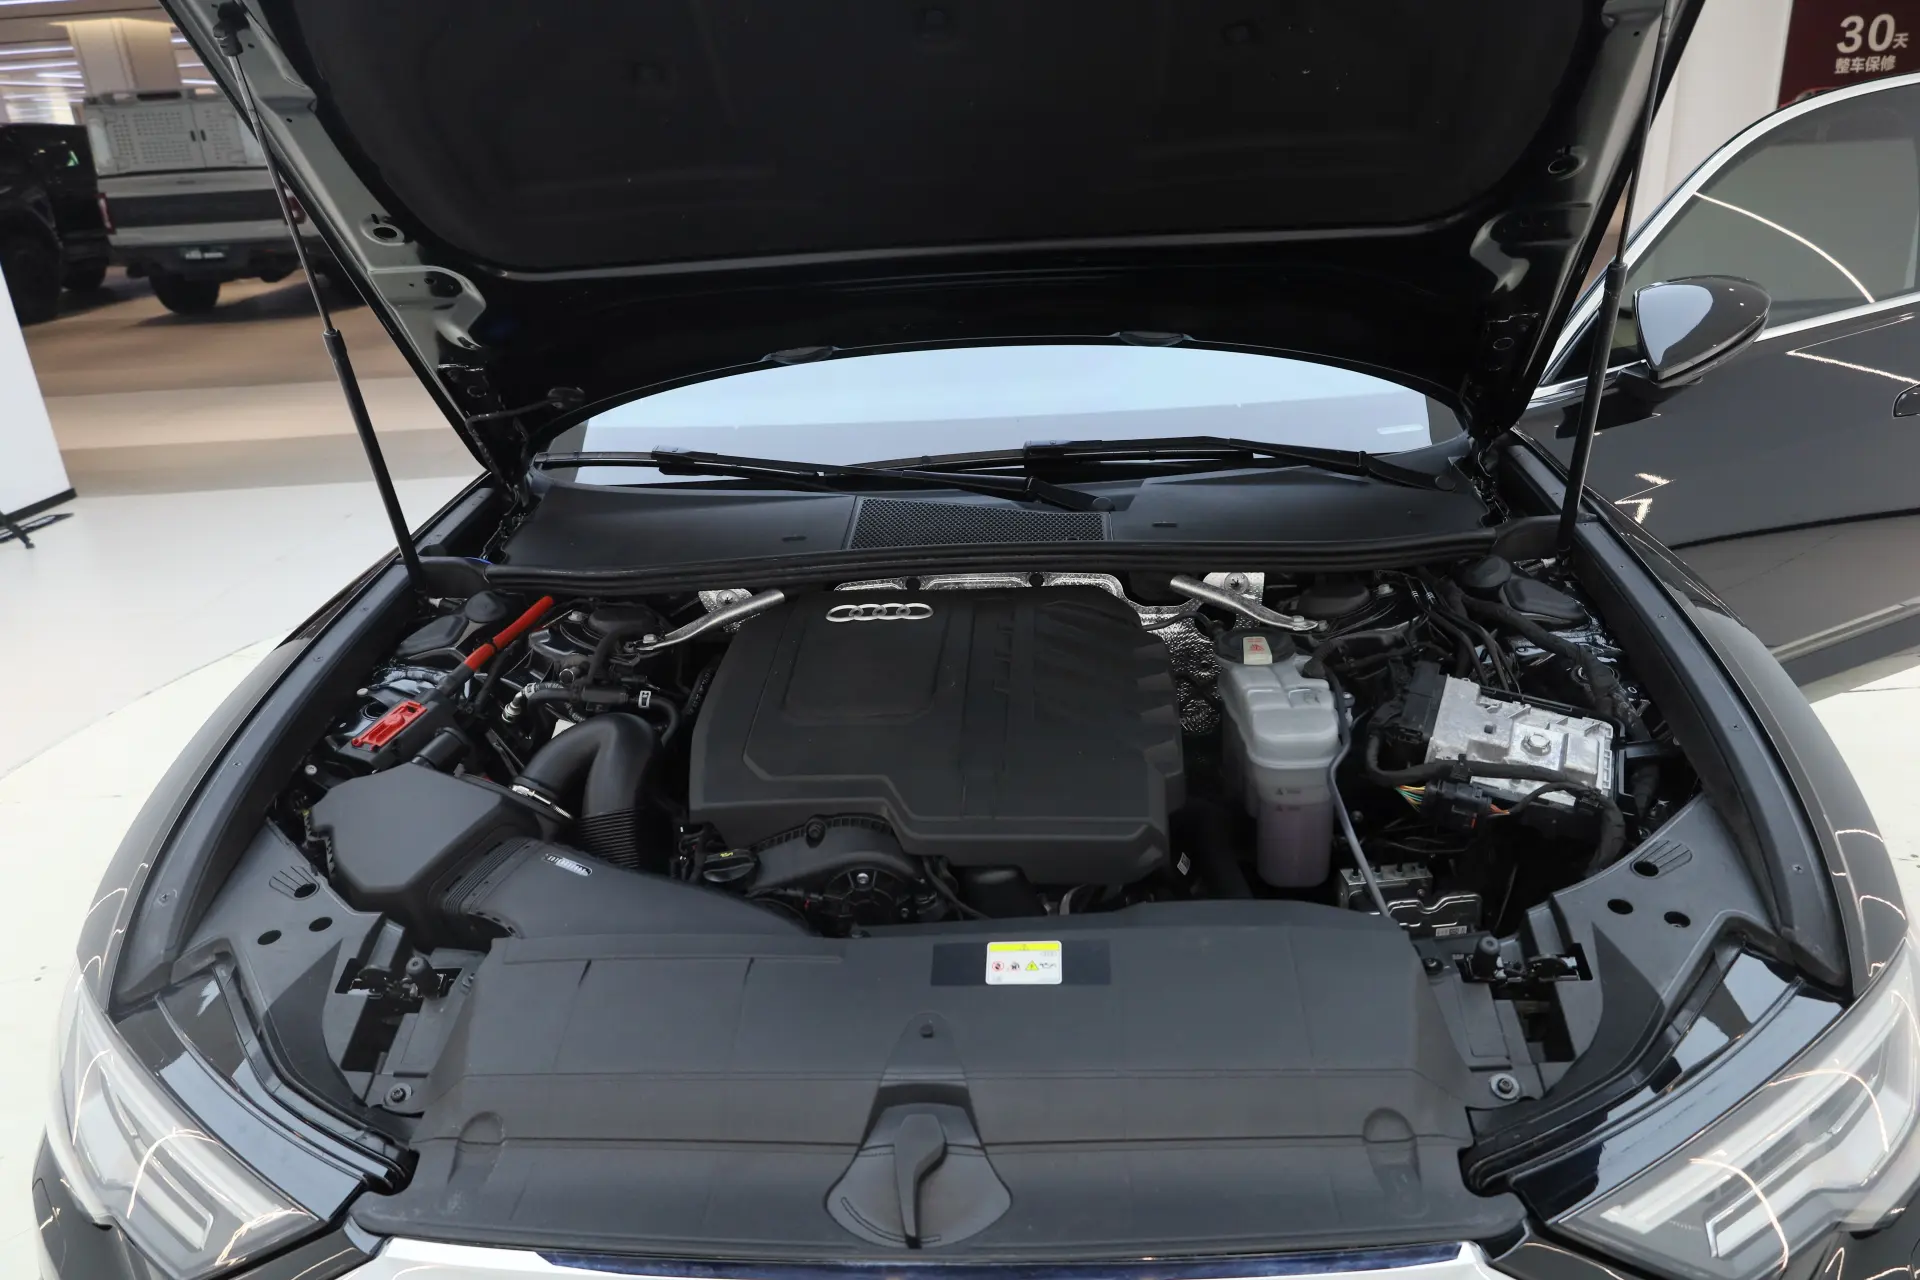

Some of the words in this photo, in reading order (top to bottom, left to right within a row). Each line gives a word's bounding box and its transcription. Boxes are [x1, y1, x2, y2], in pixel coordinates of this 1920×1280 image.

[1836, 13, 1909, 54] 30天
[1834, 55, 1897, 75] 整车保修
